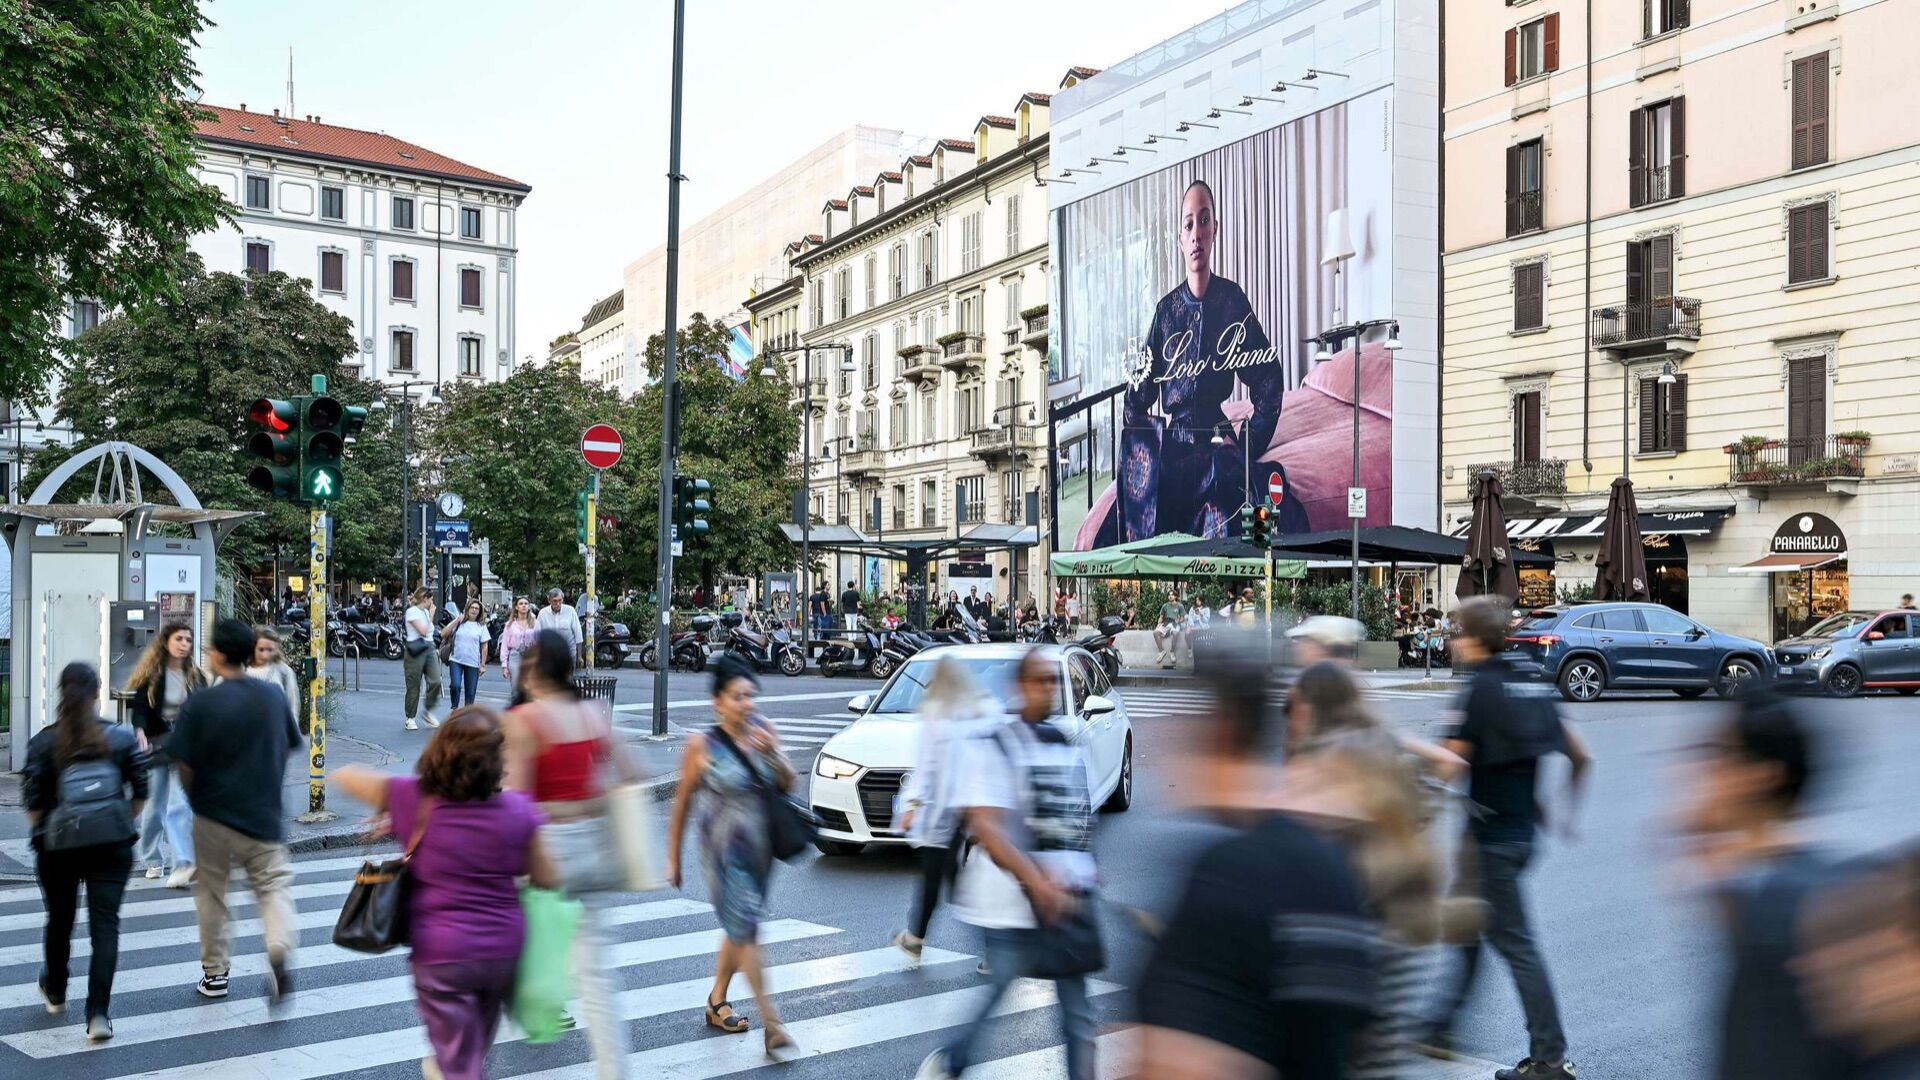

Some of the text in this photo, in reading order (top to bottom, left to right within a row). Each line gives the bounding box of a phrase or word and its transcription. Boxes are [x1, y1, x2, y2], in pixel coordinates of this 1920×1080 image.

[1153, 312, 1281, 383] Loro Piana
[1775, 536, 1839, 550] PANARELLO
[1092, 564, 1113, 573] PIZZA
[1183, 559, 1266, 576] Alice PIZZA
